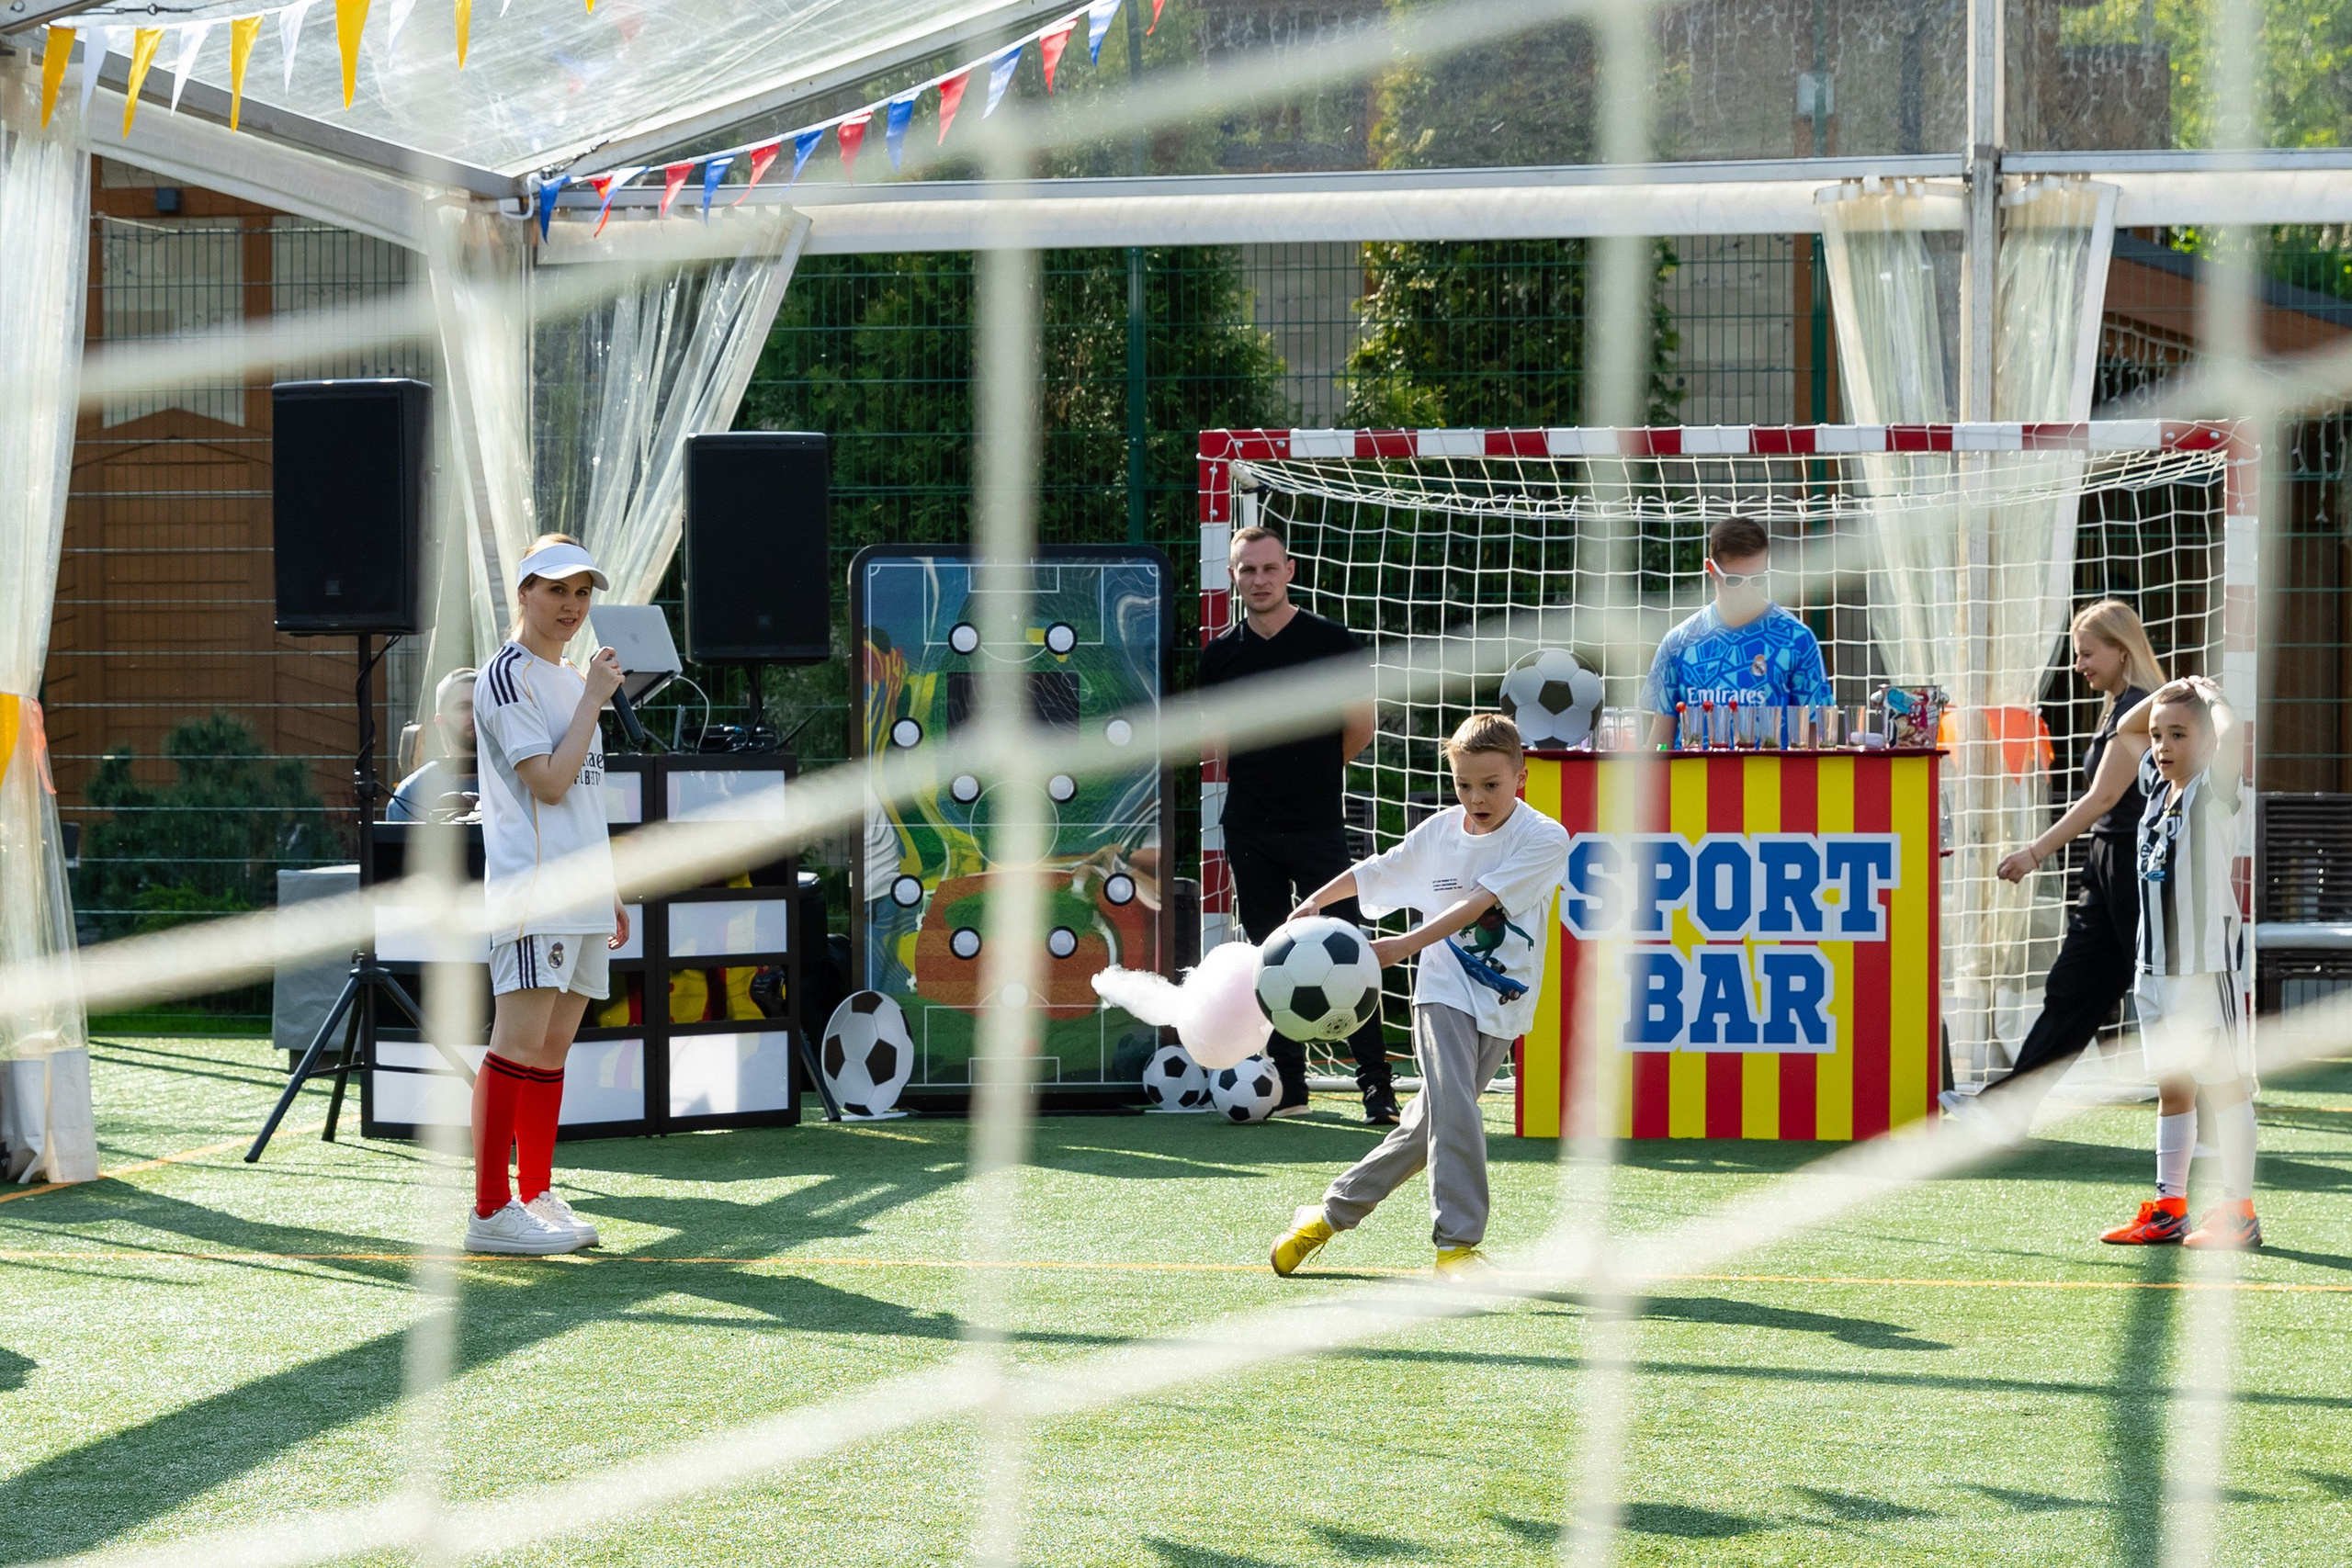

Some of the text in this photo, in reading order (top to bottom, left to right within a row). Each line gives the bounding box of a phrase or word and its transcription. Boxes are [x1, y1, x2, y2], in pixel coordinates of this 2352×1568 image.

[1687, 686, 1766, 705] Emirates
[1566, 840, 1893, 933] SPORT
[1622, 952, 1828, 1045] BAR
